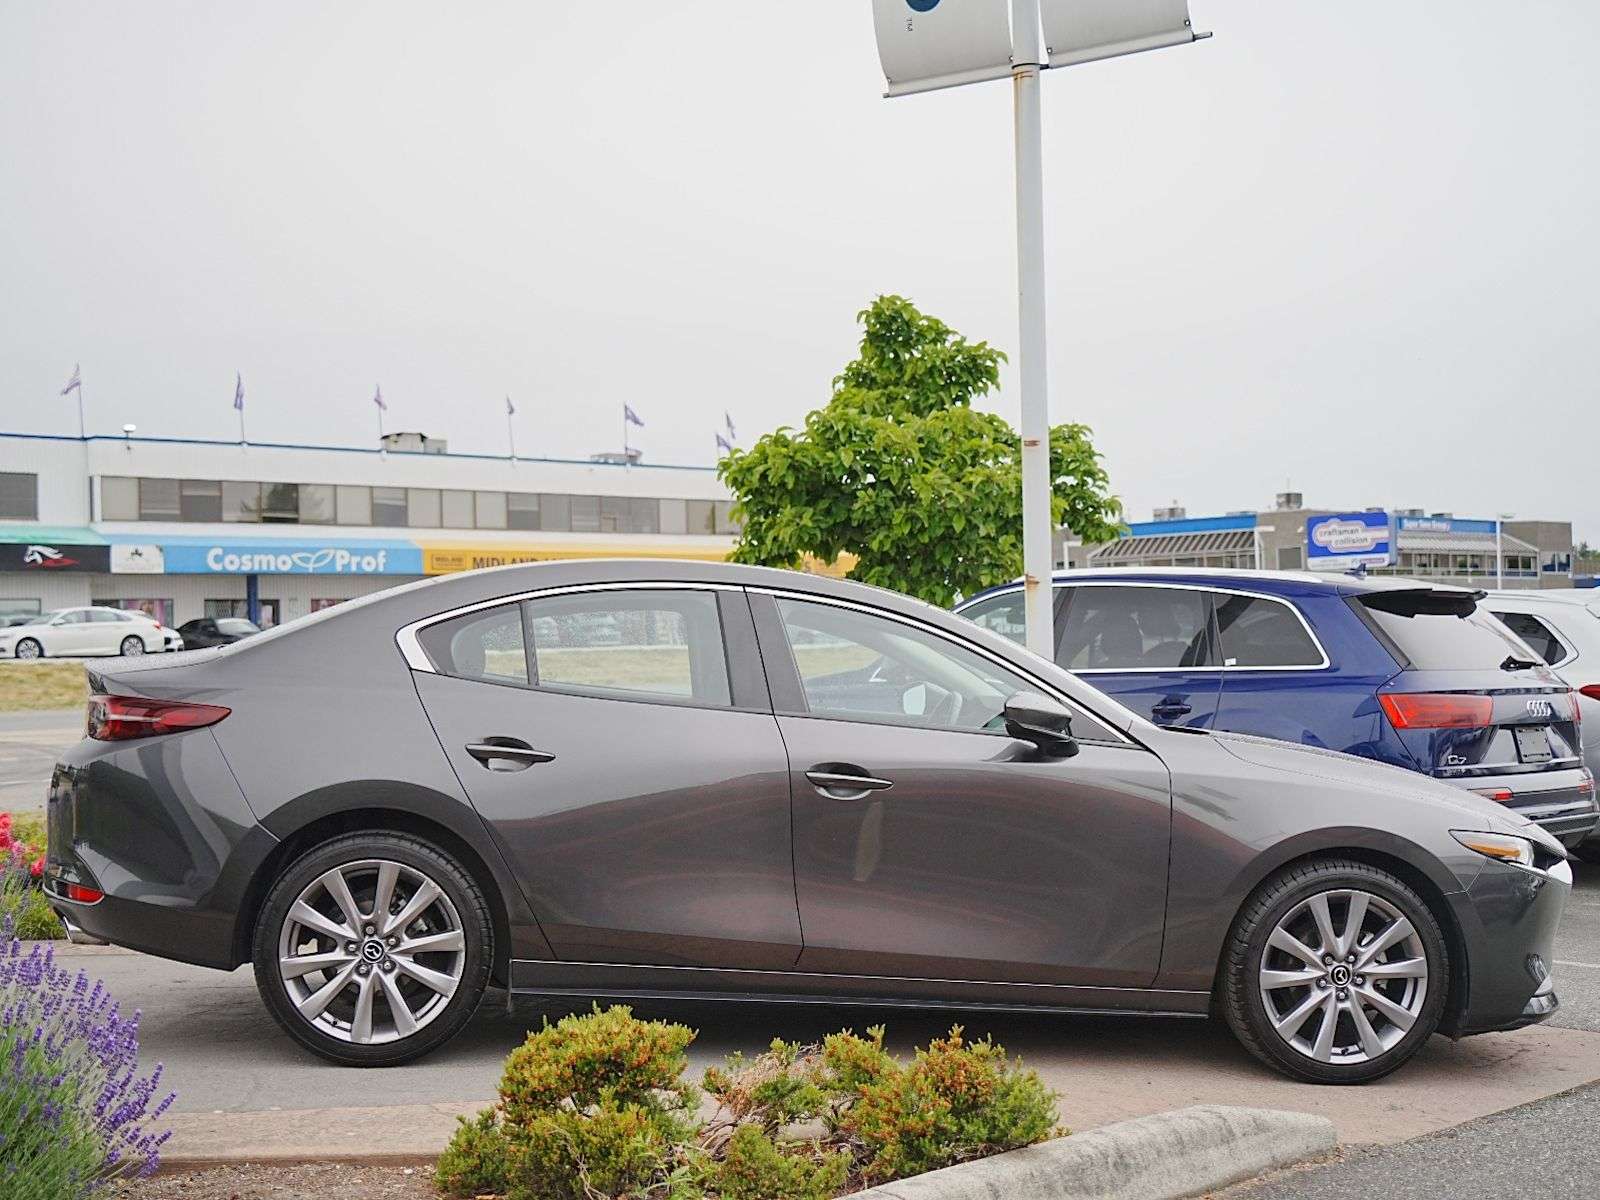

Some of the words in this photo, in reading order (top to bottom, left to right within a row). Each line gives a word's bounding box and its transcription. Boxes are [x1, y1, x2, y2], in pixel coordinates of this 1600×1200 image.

[1319, 527, 1360, 537] craftsman
[1334, 537, 1368, 545] collision
[207, 548, 293, 572] Cosmo
[335, 549, 387, 573] Prof
[472, 556, 538, 569] MIDLA
